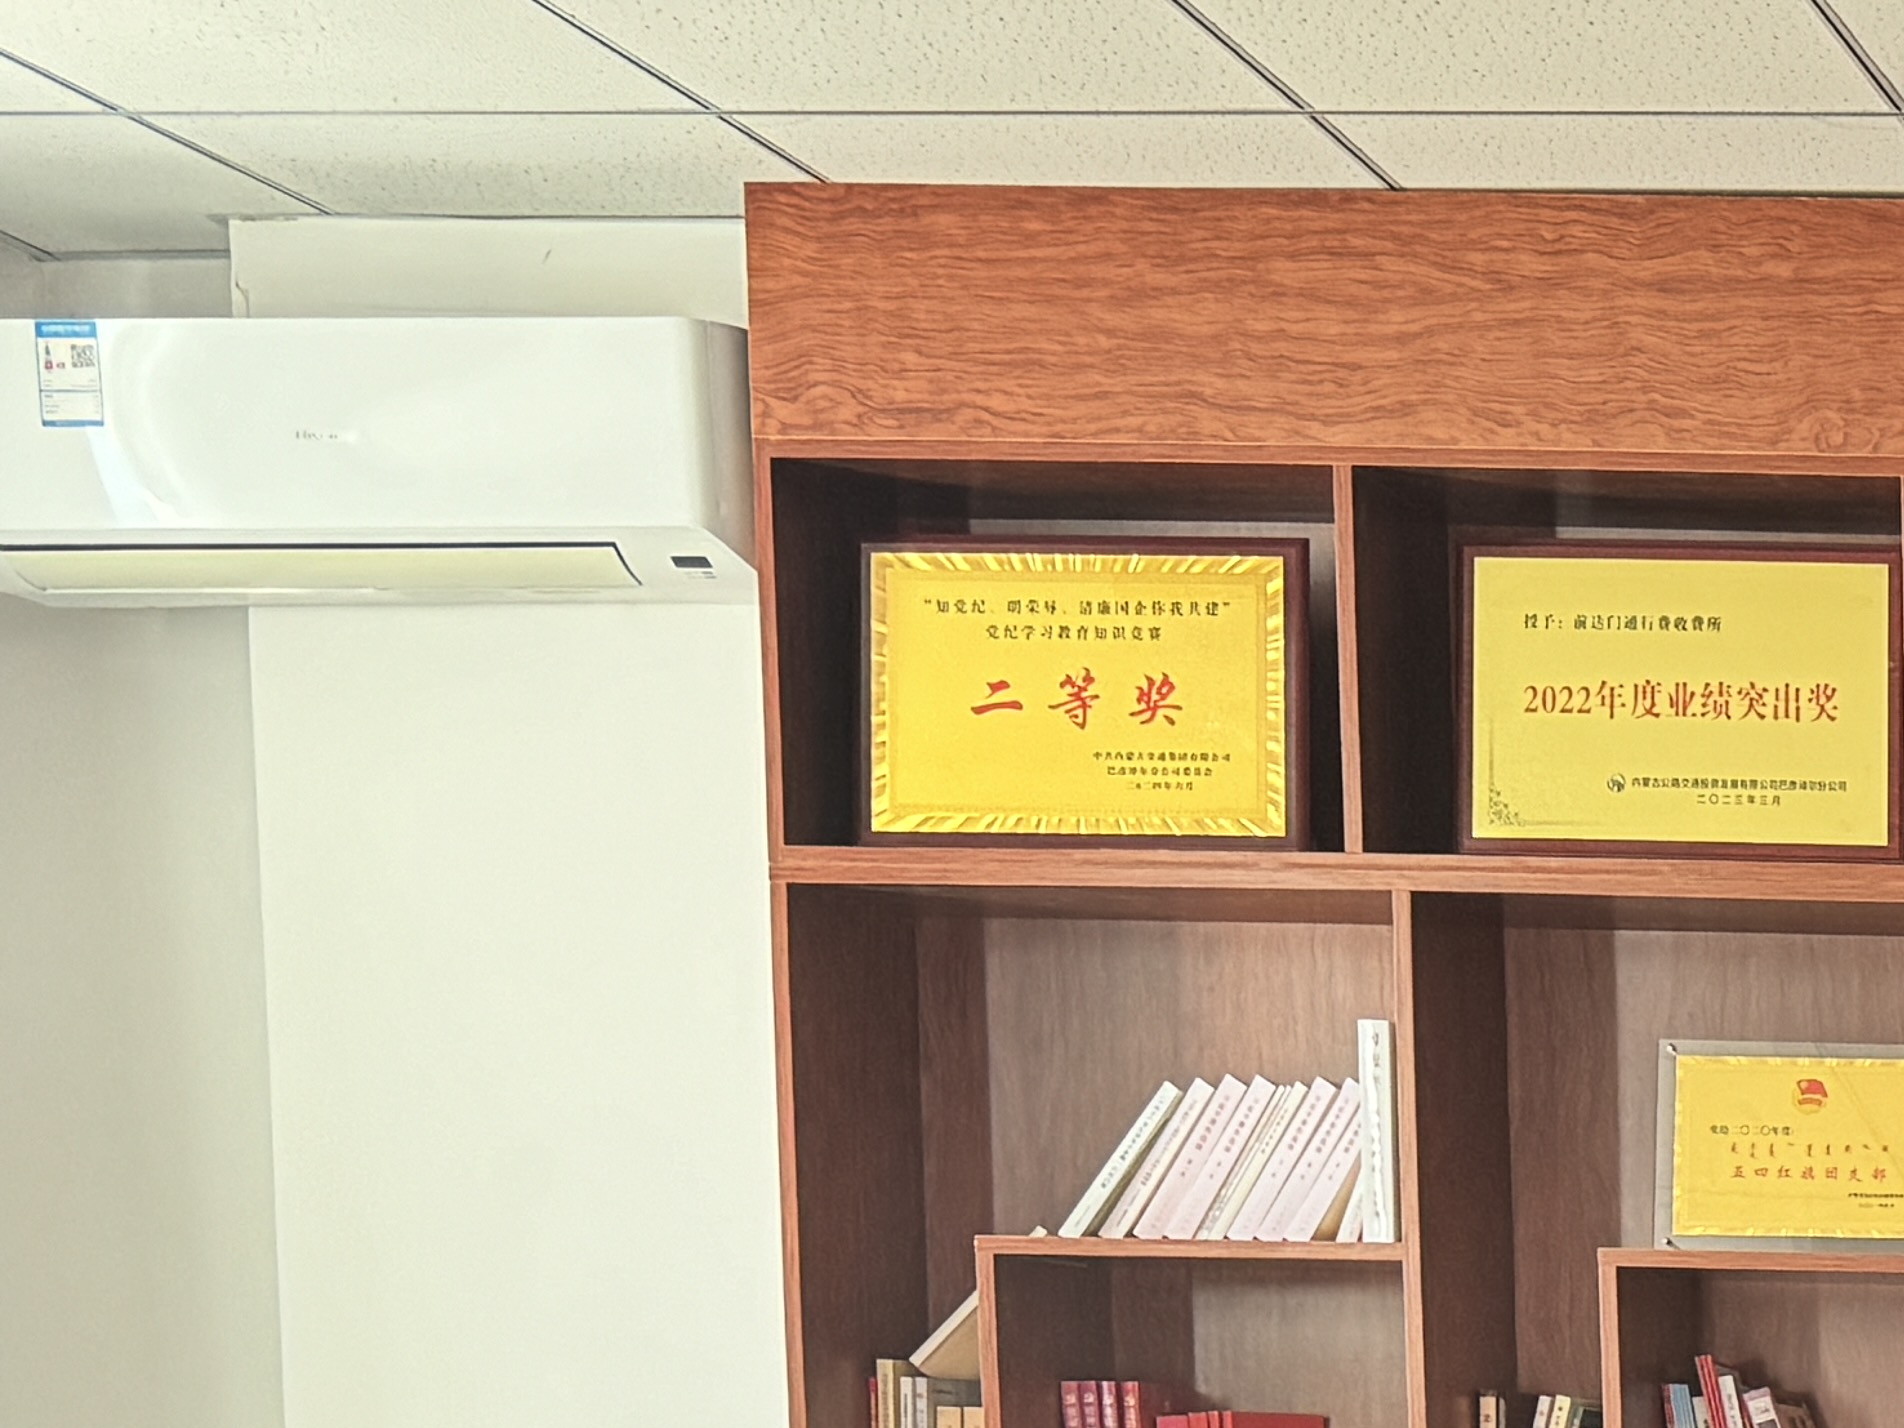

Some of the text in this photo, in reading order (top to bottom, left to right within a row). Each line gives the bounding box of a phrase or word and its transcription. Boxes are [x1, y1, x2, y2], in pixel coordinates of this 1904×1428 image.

[986, 624, 1163, 642] 党纪学习教育知识竞赛
[970, 667, 1184, 730] 二等奖
[1523, 679, 1839, 723] 2022年度业绩突出奖
